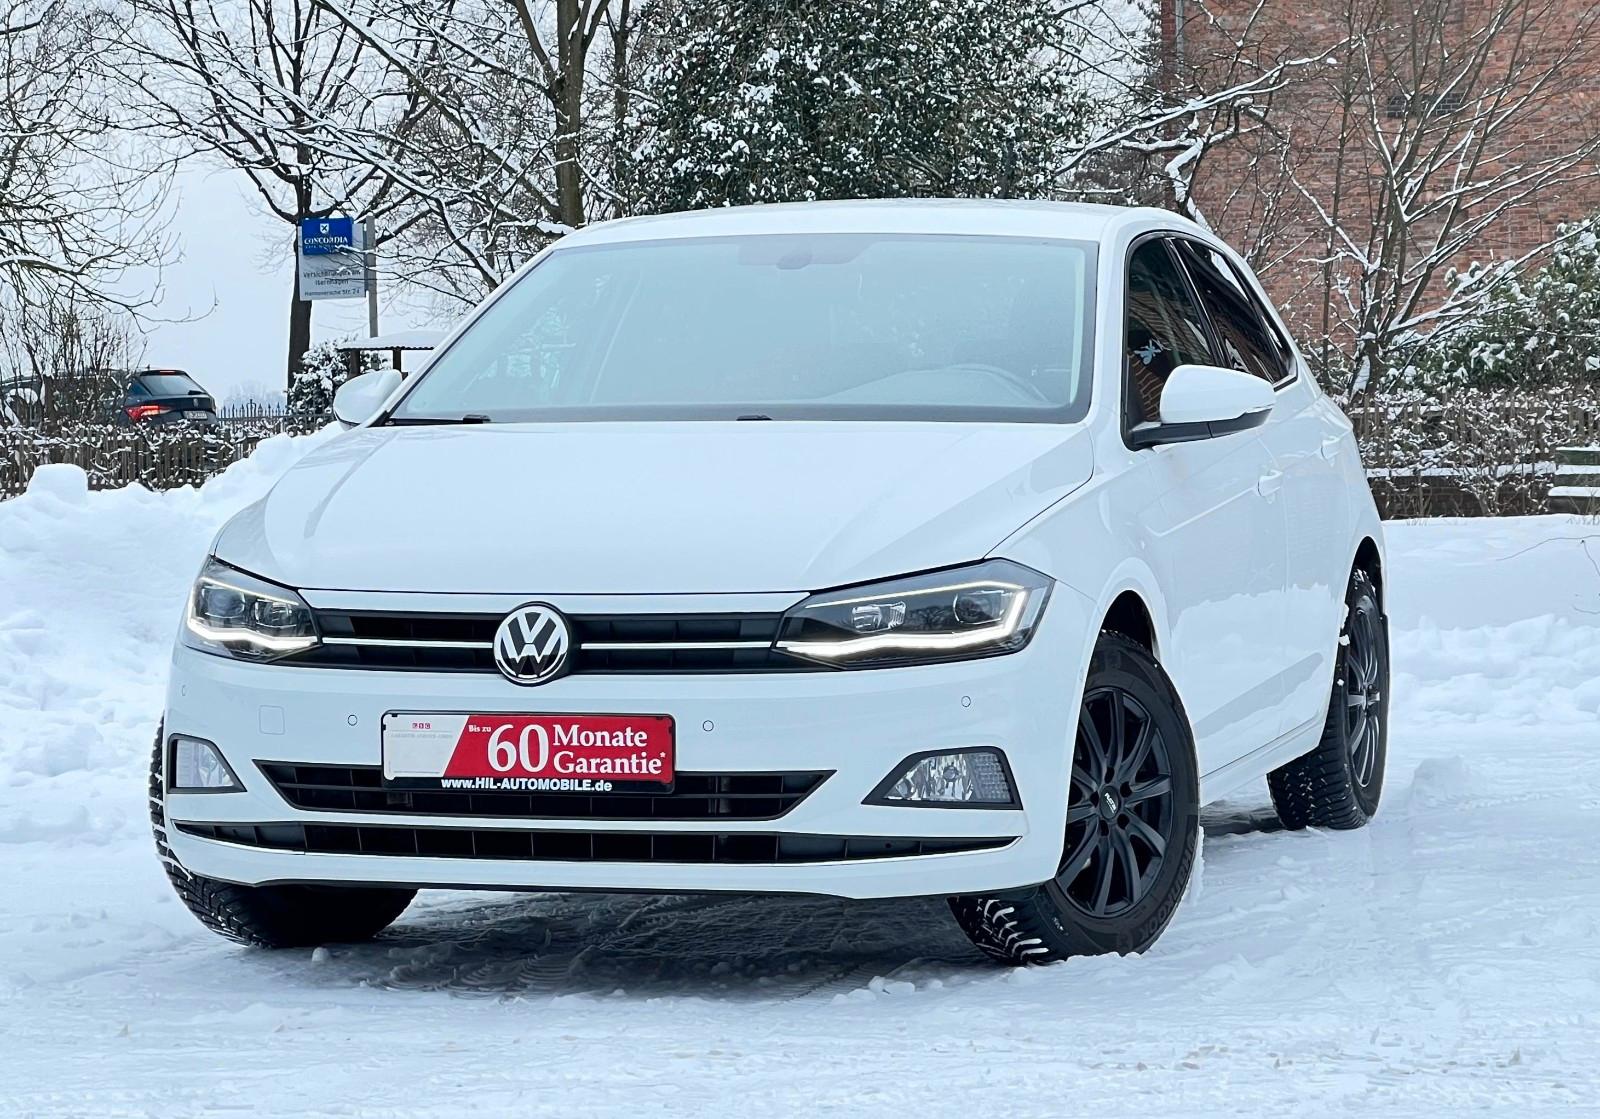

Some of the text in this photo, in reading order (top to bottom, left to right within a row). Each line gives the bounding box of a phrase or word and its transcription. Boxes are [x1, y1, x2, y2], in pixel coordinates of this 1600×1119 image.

[304, 236, 348, 245] CONCORDIA
[468, 724, 481, 733] Bis
[487, 724, 549, 773] 60
[552, 724, 648, 747] Monate
[441, 777, 613, 791] www.HIL-AUTOMOBILE.de
